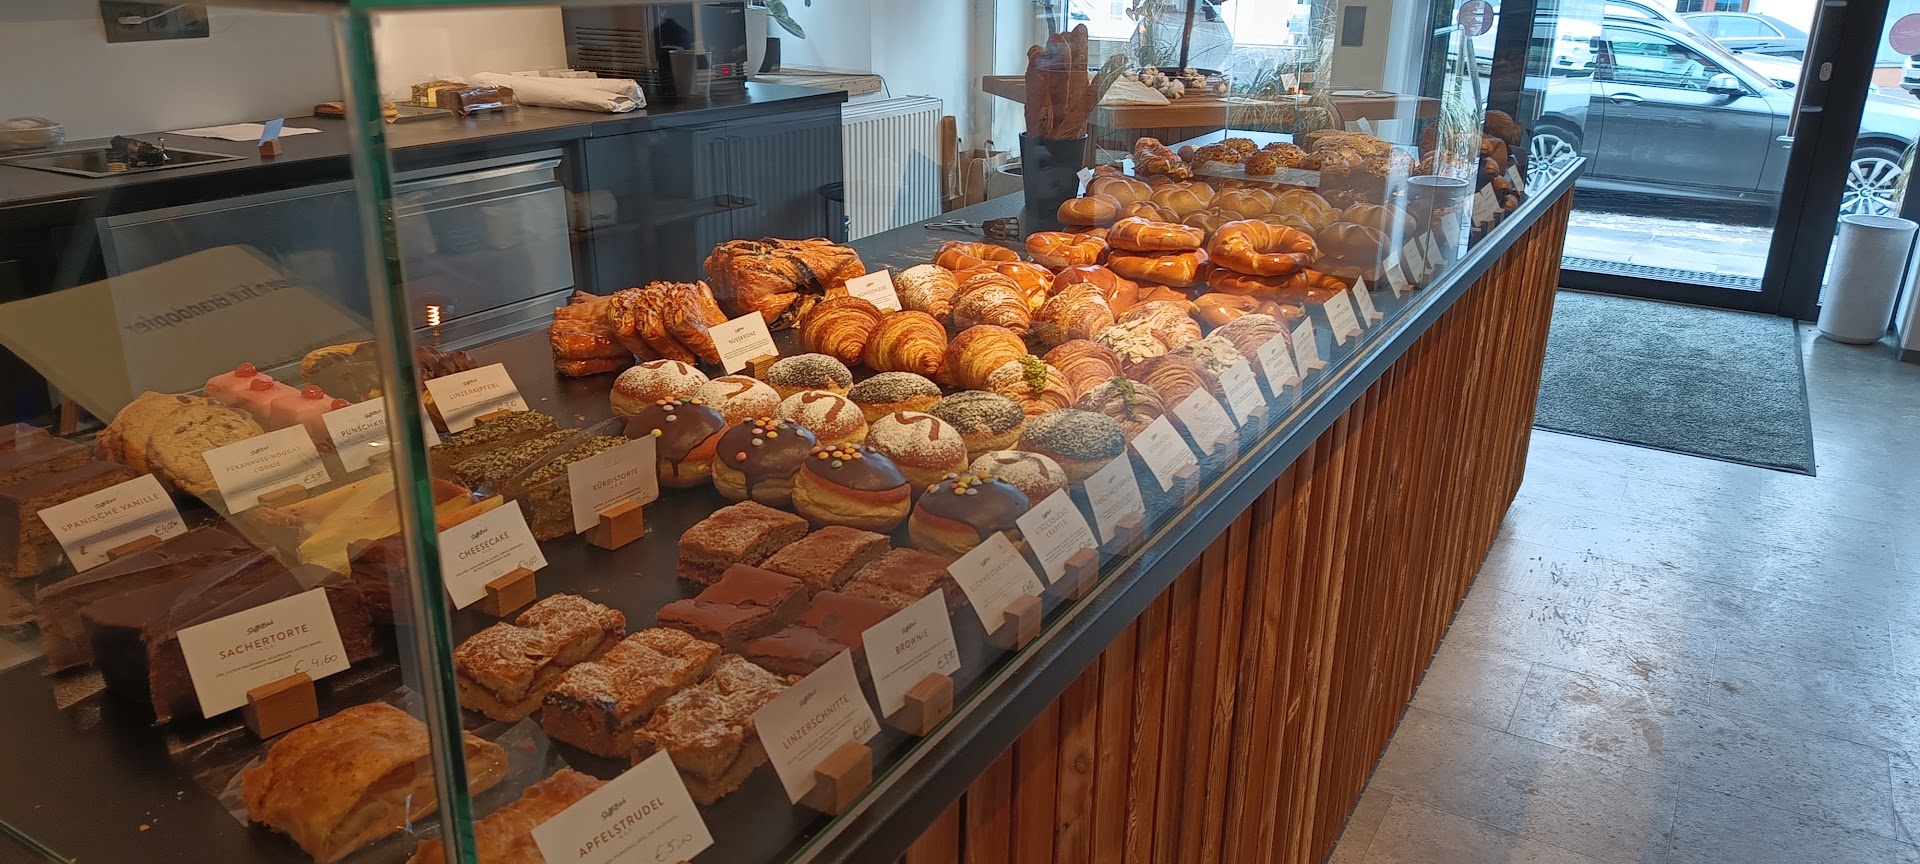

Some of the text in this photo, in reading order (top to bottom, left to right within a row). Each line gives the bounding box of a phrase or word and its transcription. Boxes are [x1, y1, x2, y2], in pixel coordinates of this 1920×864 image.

[448, 382, 501, 400] LINZERKIPFERL
[225, 445, 302, 473] PEKANNUSS-NOUGAT
[253, 461, 282, 475] COOKIE
[592, 467, 639, 492] KÜRBISTORTE
[60, 506, 121, 534] SPANISCHE
[120, 492, 161, 512] VANILLE
[458, 530, 511, 560] CHEESECAKE
[218, 623, 310, 661] SACHERTORTE
[895, 628, 930, 656] BROWNIE
[782, 691, 850, 750] LINZERSCHNITTE
[578, 796, 665, 859] APFELSTRUDEL
